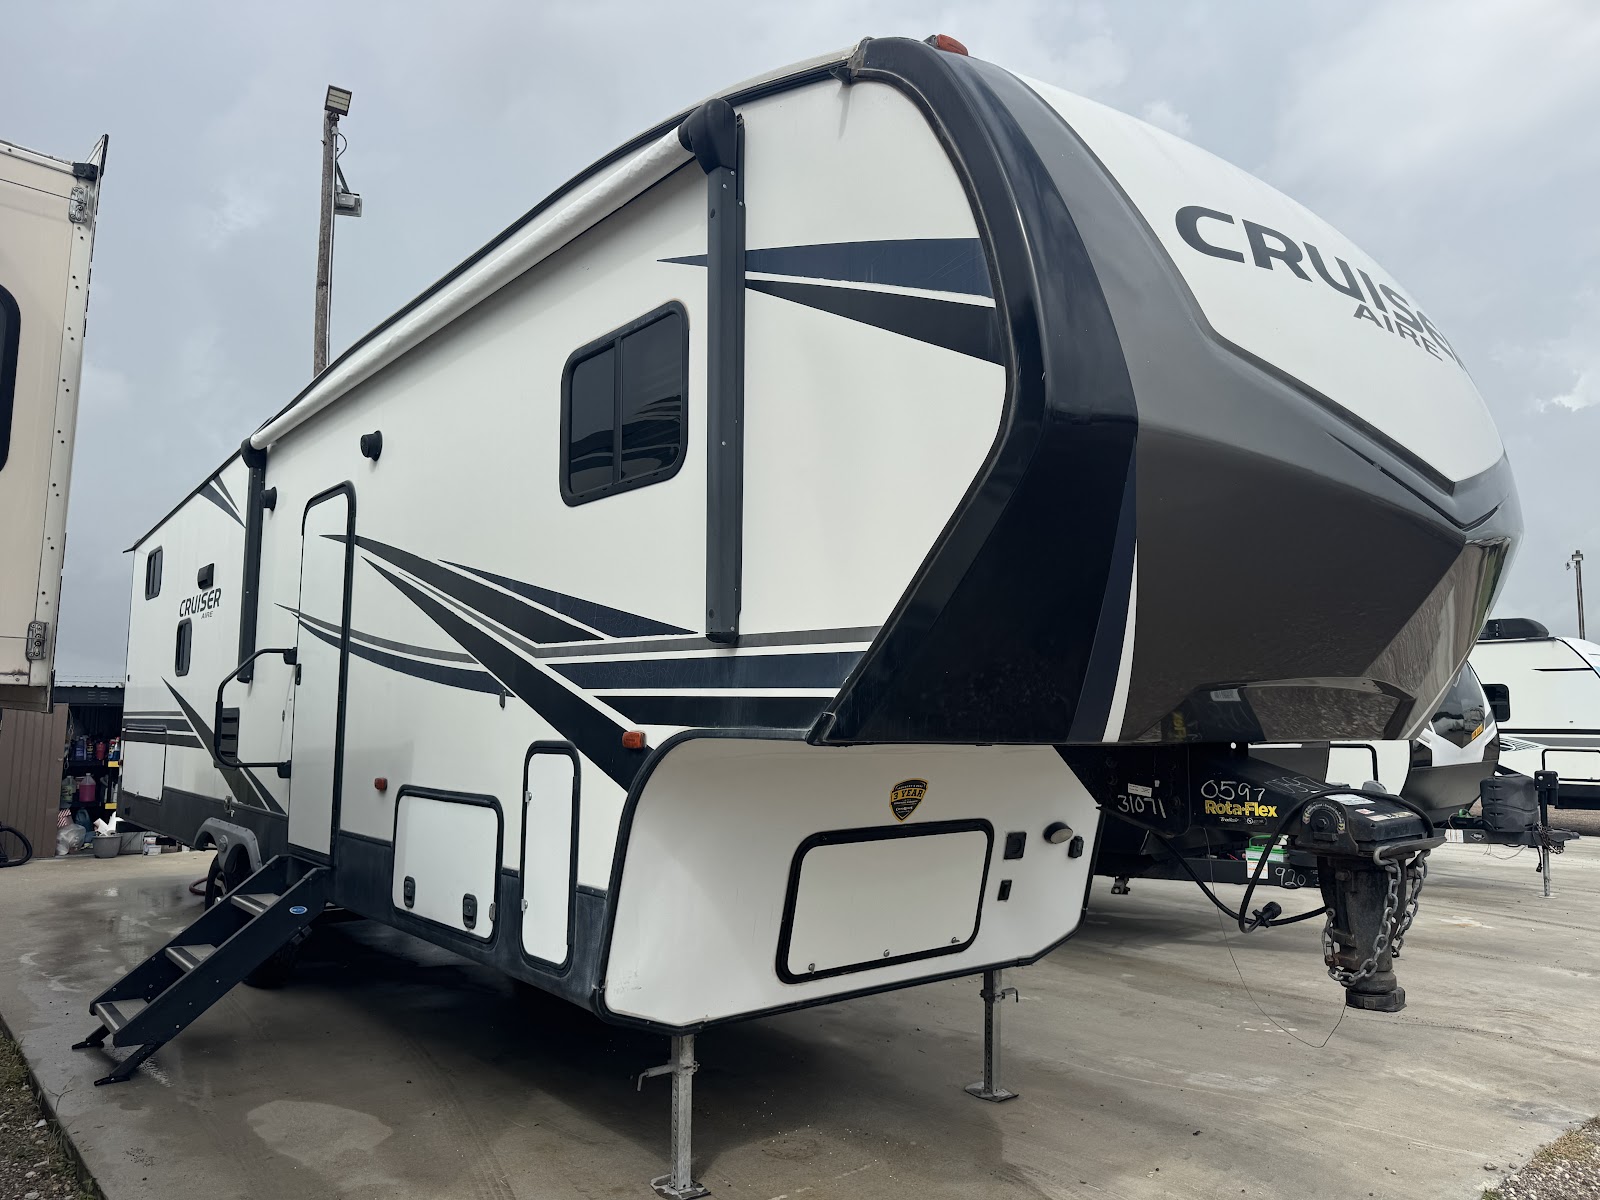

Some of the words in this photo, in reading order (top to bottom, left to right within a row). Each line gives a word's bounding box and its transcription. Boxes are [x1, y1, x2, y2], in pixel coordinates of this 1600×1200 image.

[1175, 205, 1466, 370] CRUISE
[1353, 303, 1443, 361] AIRE
[179, 588, 221, 617] CRUISER
[893, 791, 899, 800] 3
[901, 789, 923, 798] YEAR
[1200, 780, 1266, 802] 0597
[1117, 795, 1167, 819] 31071
[1275, 867, 1307, 887] 920
